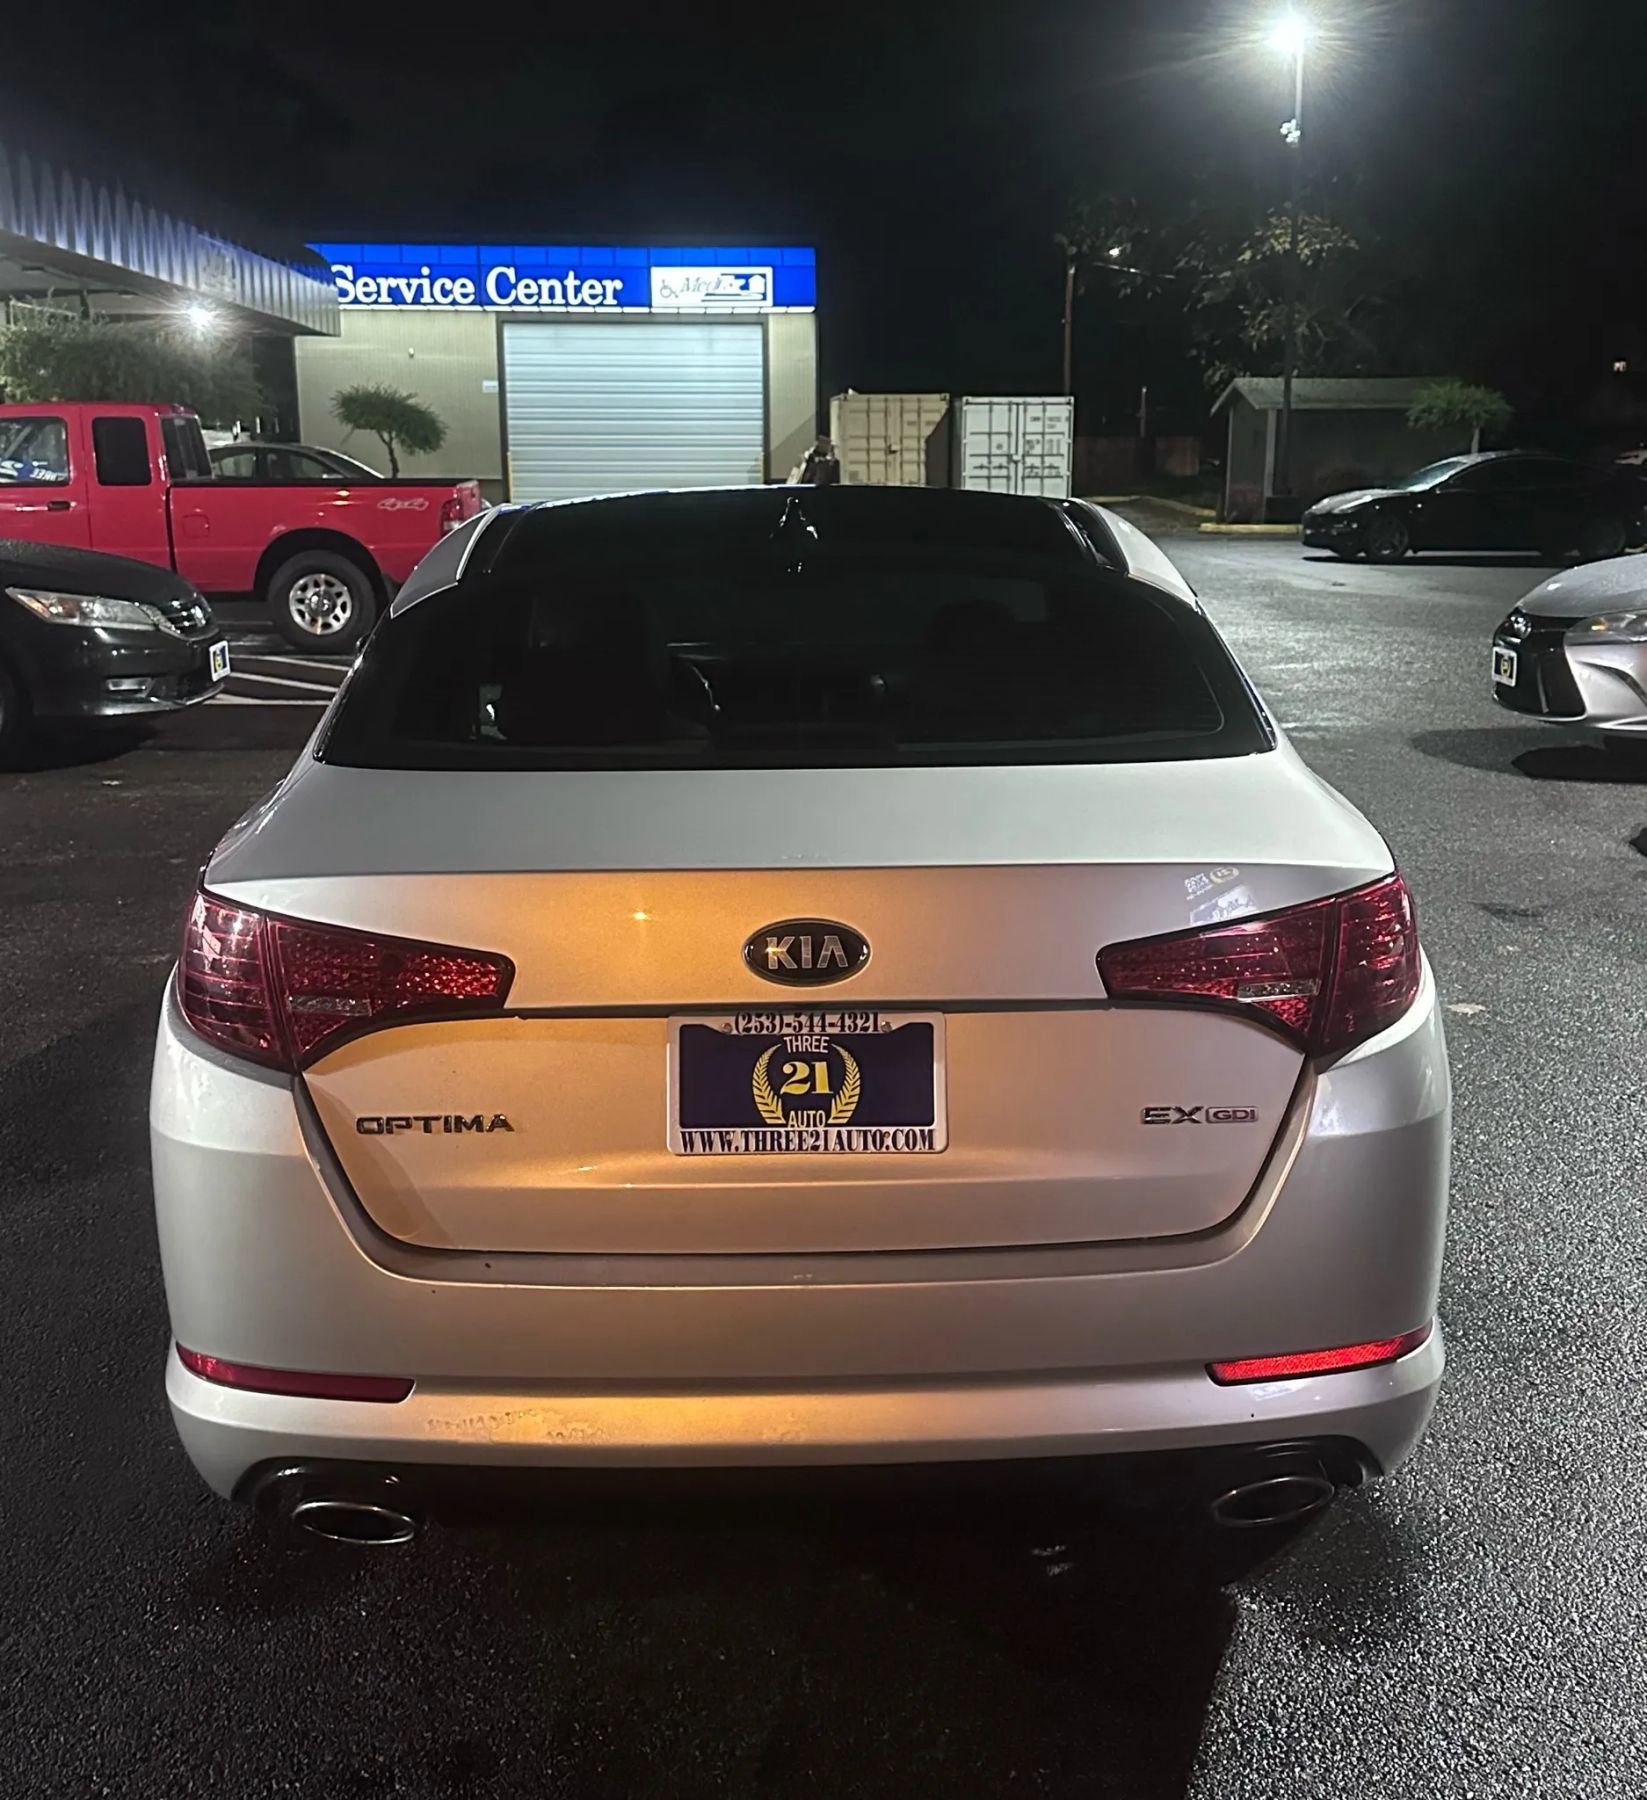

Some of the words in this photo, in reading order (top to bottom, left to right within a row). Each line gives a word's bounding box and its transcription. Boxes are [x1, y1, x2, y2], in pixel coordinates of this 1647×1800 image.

[331, 264, 475, 304] Service
[486, 266, 623, 305] Center
[765, 935, 849, 969] KIA
[734, 1011, 880, 1034] (253)-544-4321
[783, 1035, 830, 1053] THREE
[780, 1061, 834, 1095] 21
[356, 1114, 515, 1135] OPTIMA
[787, 1110, 826, 1129] AUTO
[1142, 1106, 1204, 1125] EX
[1213, 1109, 1256, 1121] GDI
[679, 1128, 936, 1153] WWW.THREE21AUTO.COM
